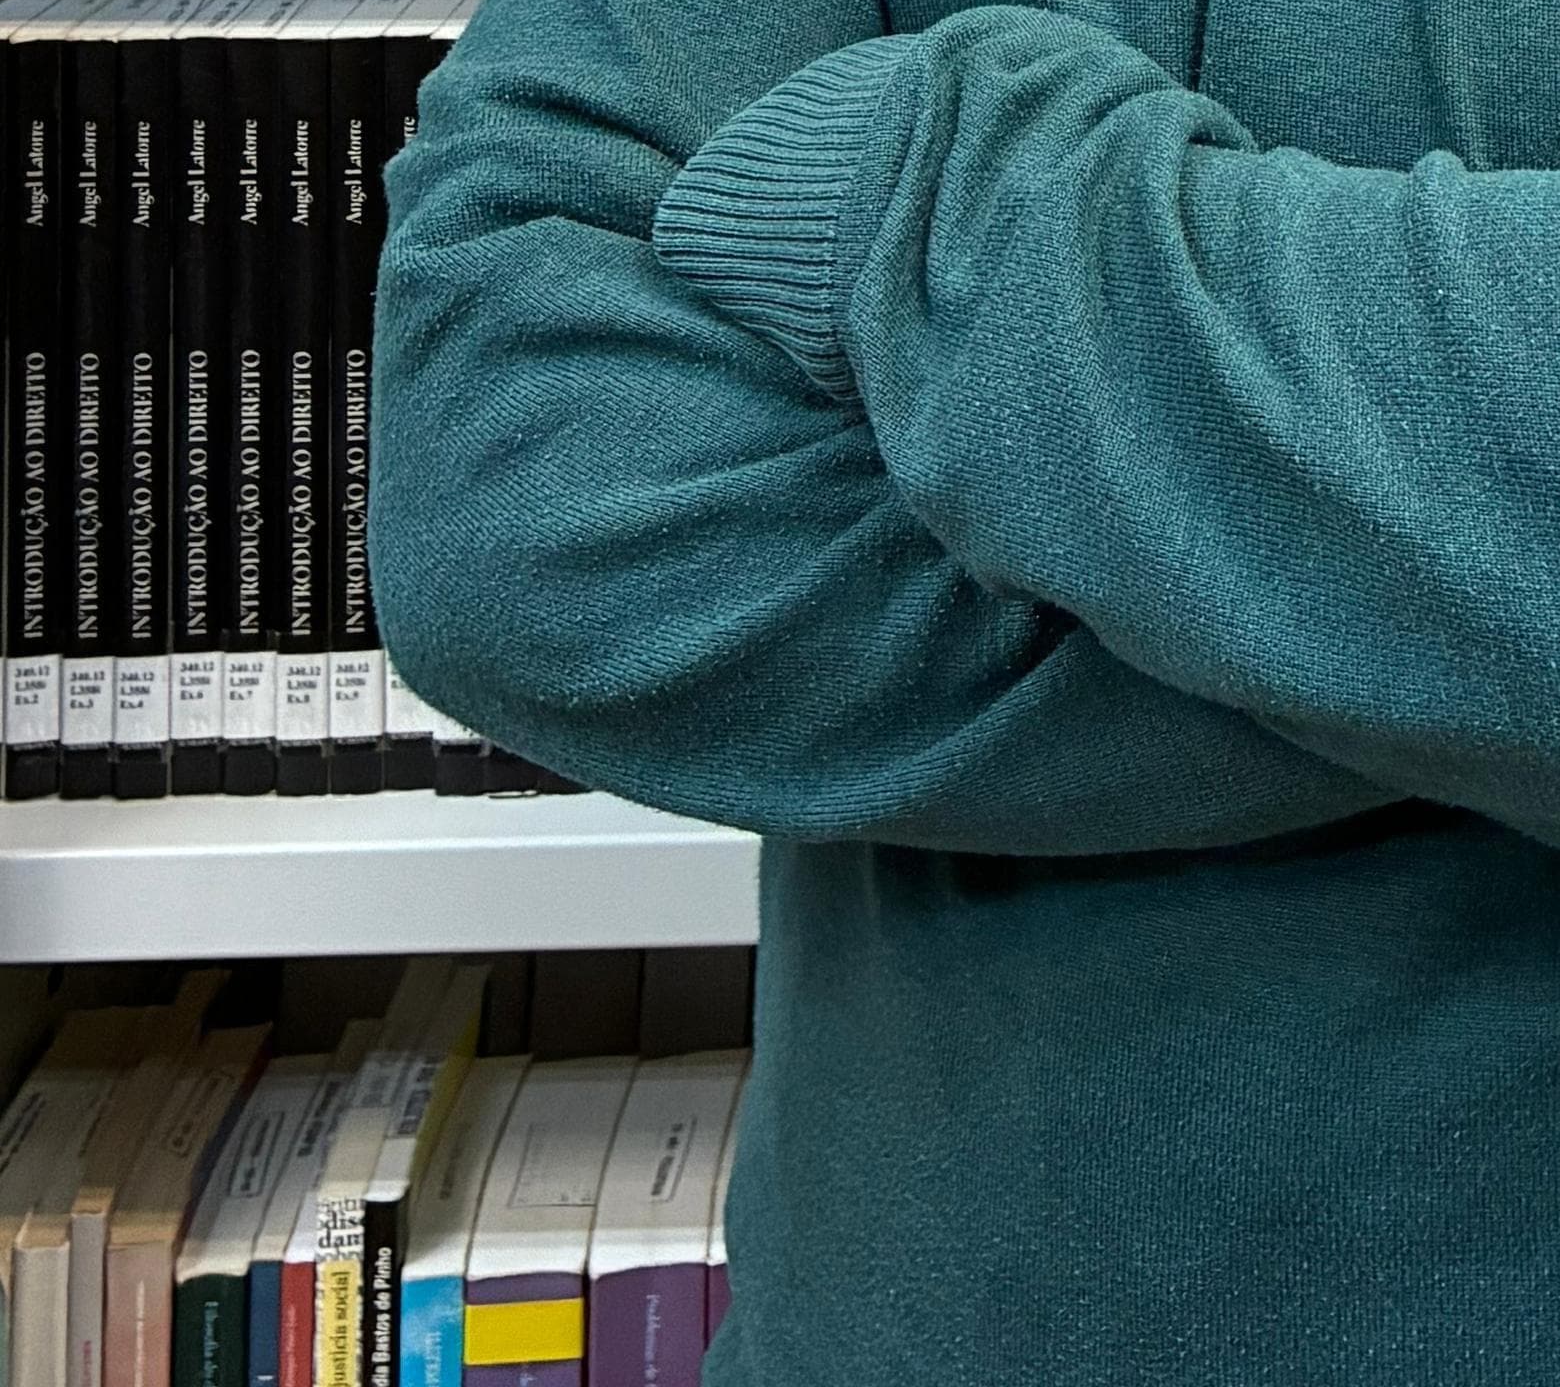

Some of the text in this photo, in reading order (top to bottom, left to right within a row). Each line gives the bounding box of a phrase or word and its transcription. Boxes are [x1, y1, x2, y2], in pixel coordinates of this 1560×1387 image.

[186, 119, 210, 225] Angel Latorre
[183, 350, 212, 635] INTRODUÇÃO AO DIREITO
[371, 1247, 392, 1363] Bastos de Pinho
